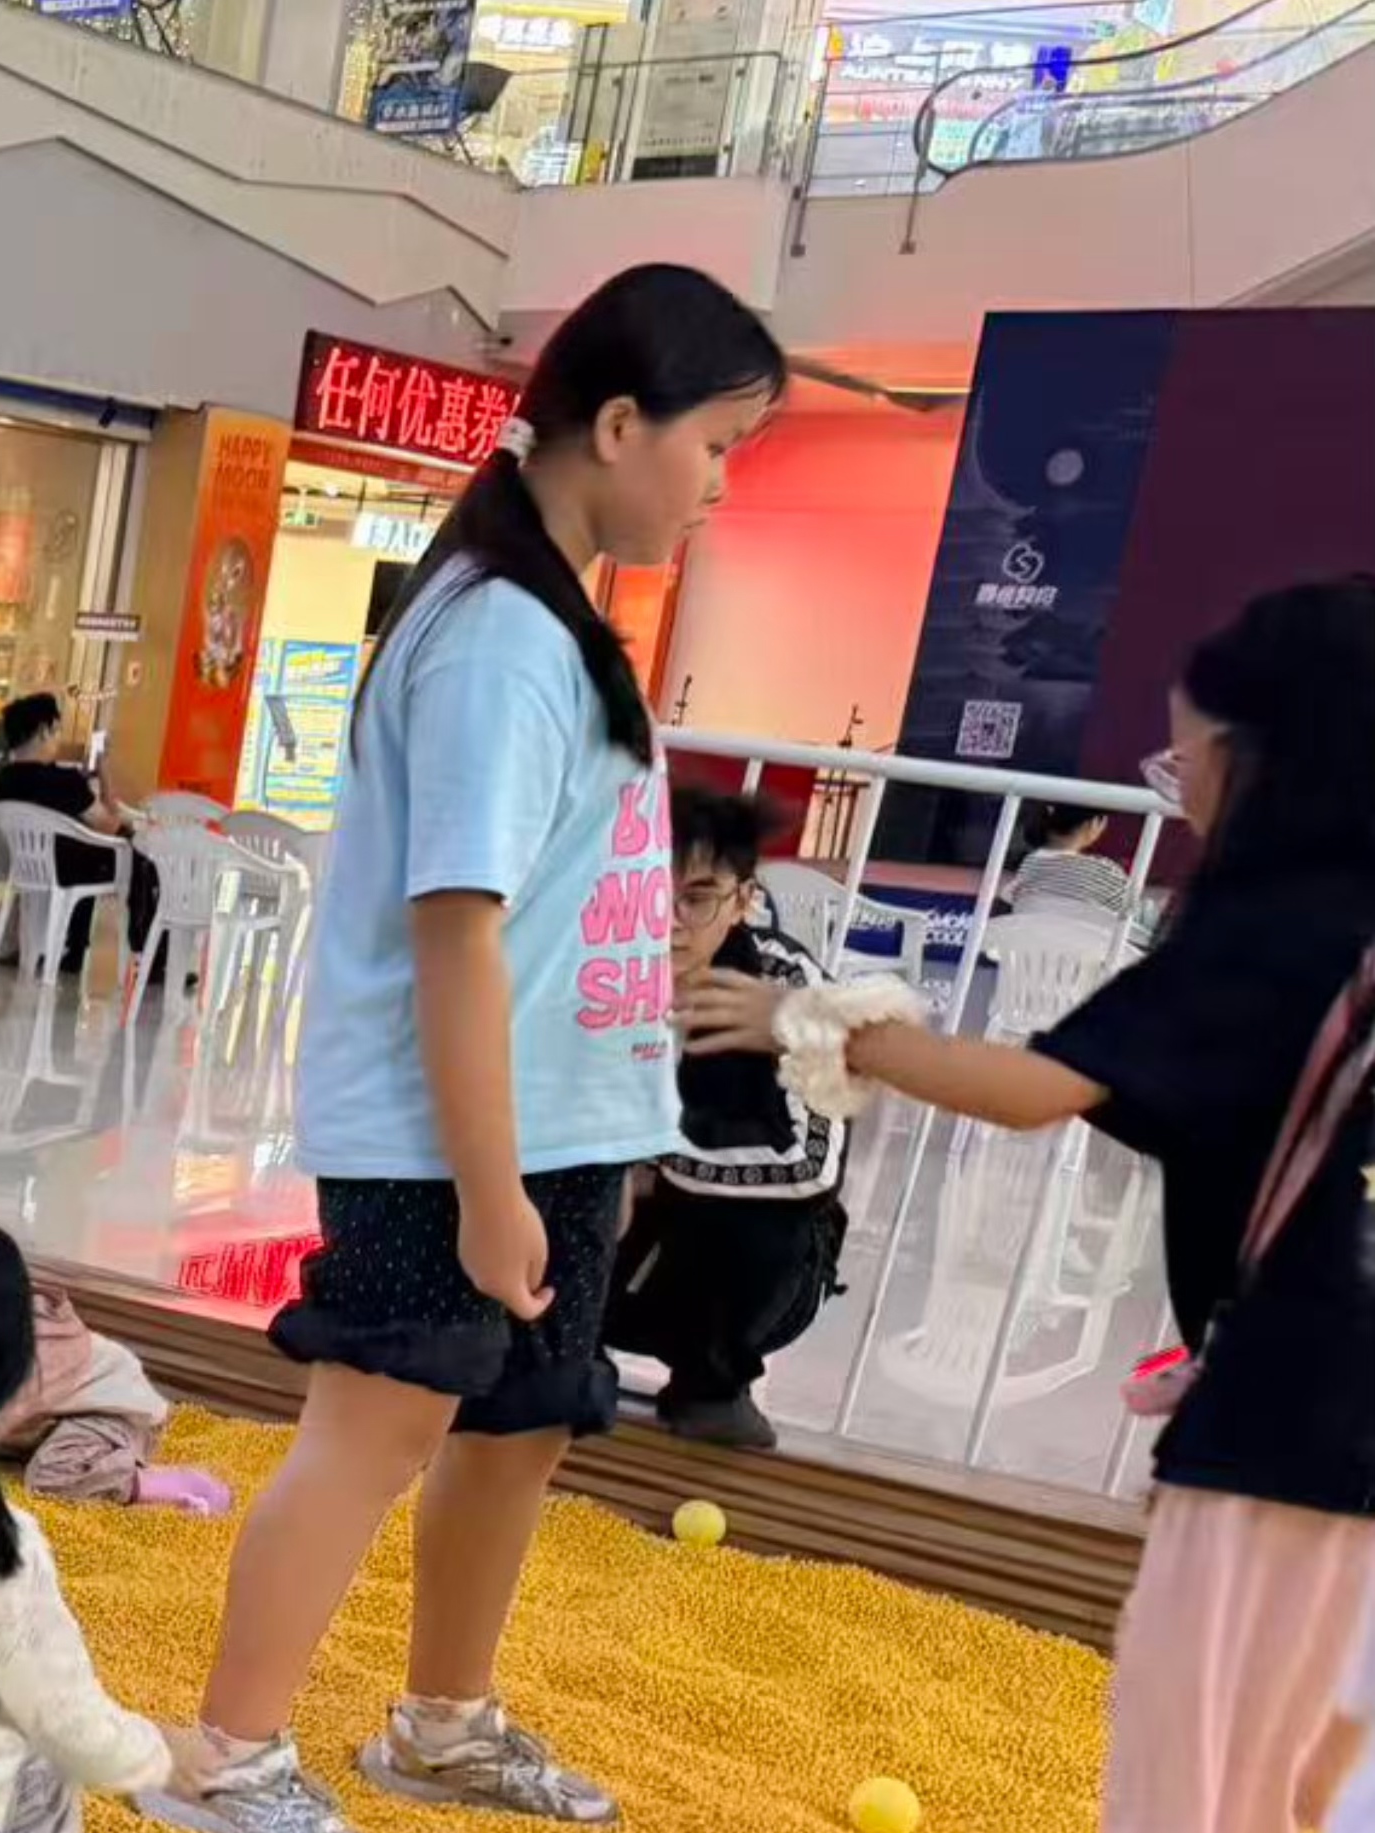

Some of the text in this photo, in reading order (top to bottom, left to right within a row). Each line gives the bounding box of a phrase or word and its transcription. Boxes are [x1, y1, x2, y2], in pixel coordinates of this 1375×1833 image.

[316, 347, 521, 461] 任何优惠券
[219, 434, 270, 466] HAPPY
[215, 462, 271, 490] MOON
